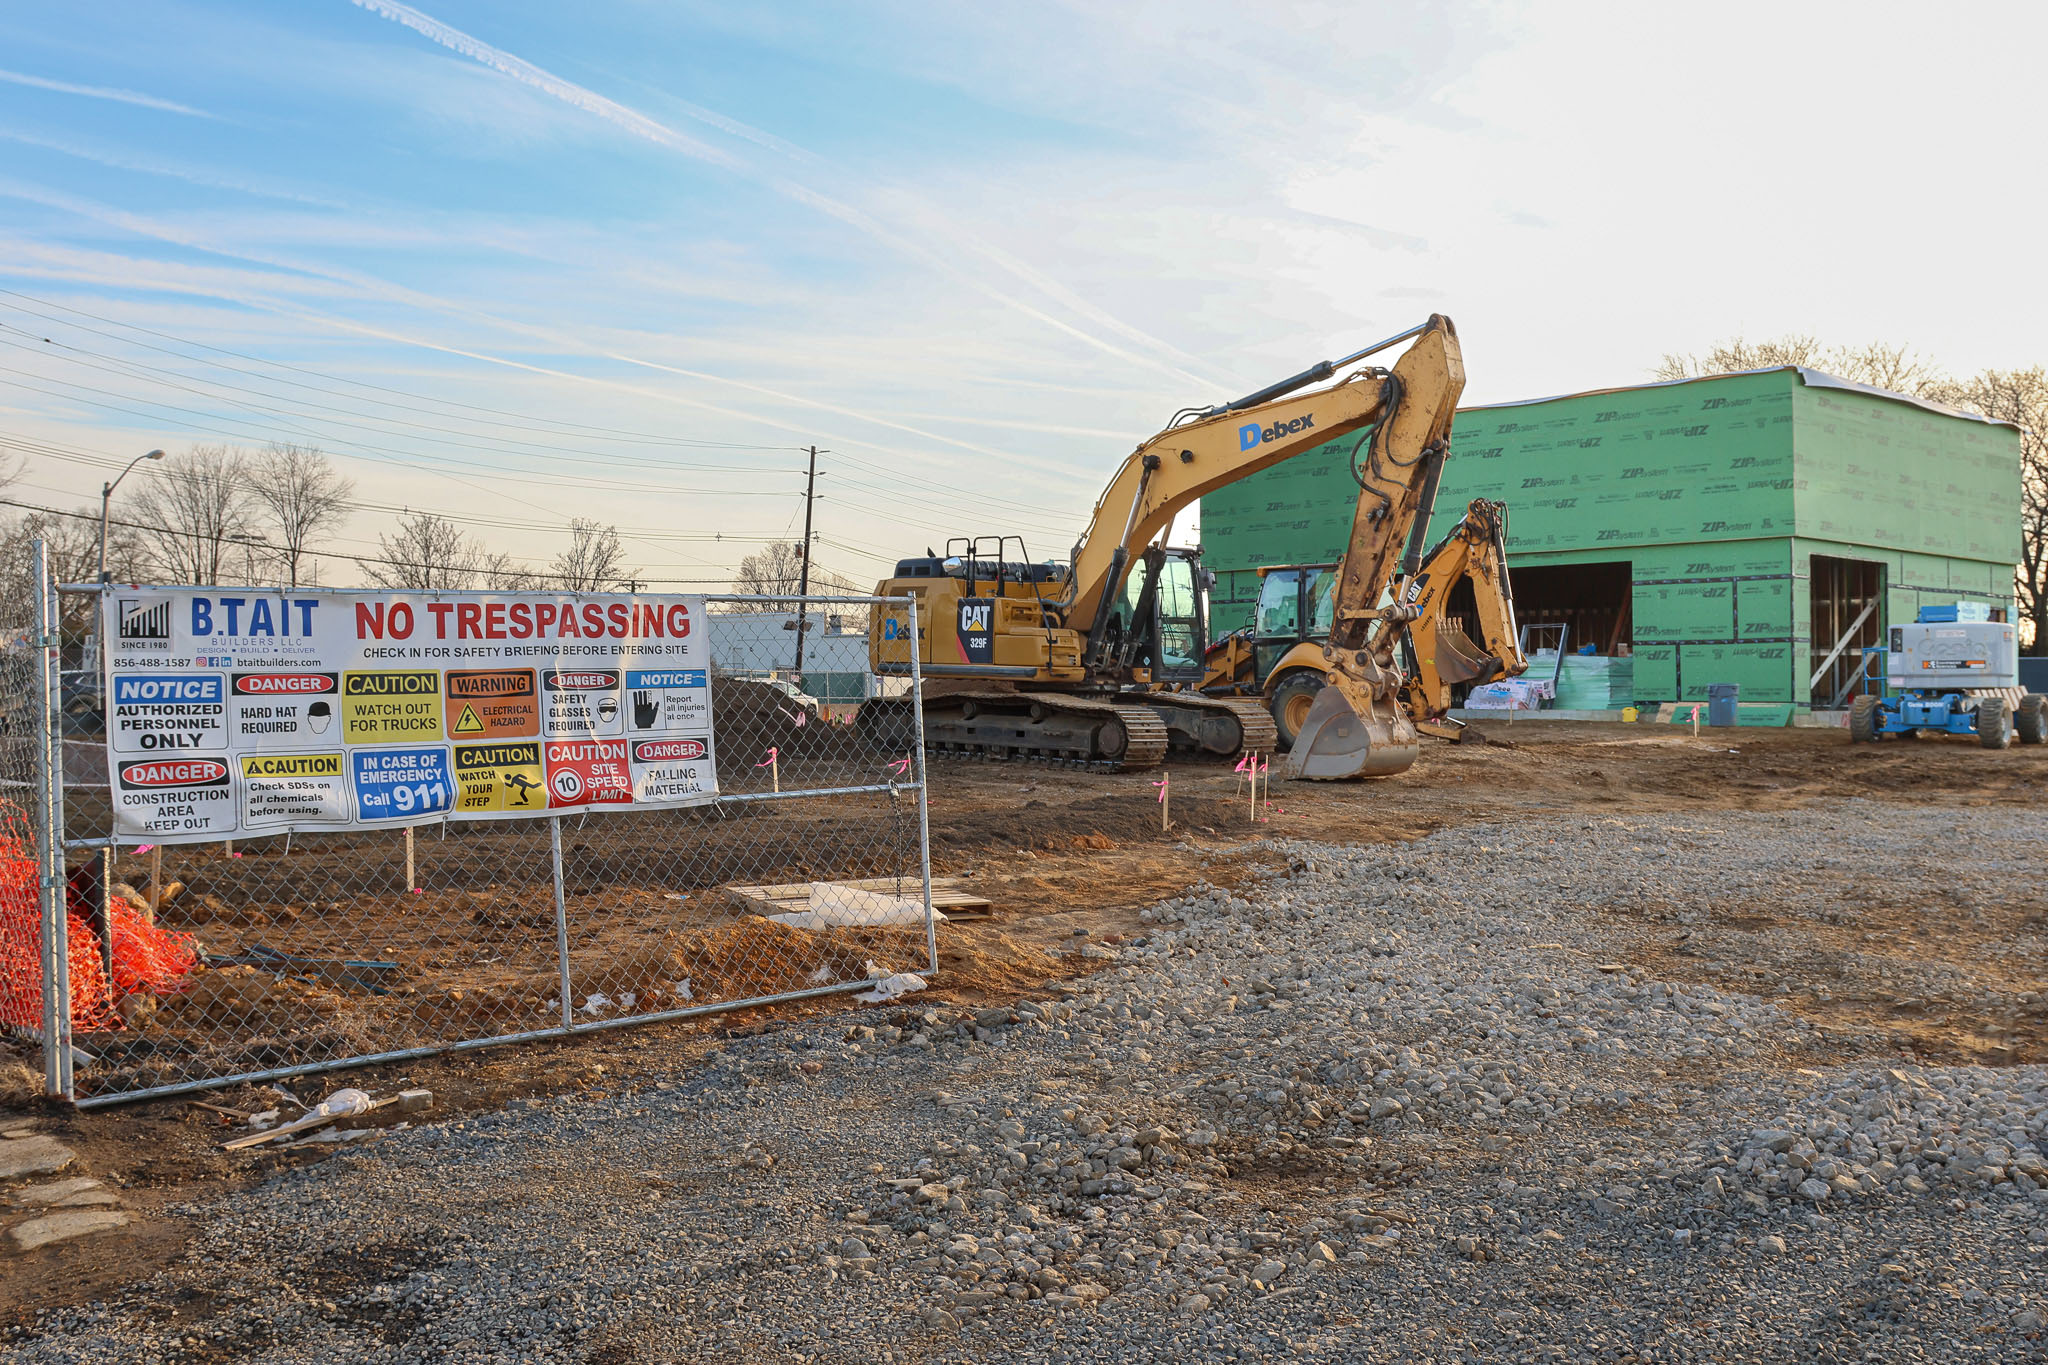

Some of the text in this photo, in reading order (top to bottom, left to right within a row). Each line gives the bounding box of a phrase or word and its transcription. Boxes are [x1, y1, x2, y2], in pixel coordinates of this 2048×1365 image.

[1239, 413, 1315, 451] Debex
[1408, 581, 1423, 602] CAT
[191, 597, 319, 637] B.TAIT
[356, 602, 690, 640] NO TRESPASSING
[962, 605, 990, 632] CAT
[885, 618, 926, 640] Debx
[121, 641, 168, 649] SINCE 1980
[211, 637, 303, 646] BUILDERS LLC
[970, 637, 988, 648] 329F
[363, 645, 688, 658] CHECK IN FOR SAFETY BRIEFING BEFORE ENTERING SITE
[114, 658, 191, 668] 856-488-1587
[237, 657, 321, 667] btaitbuilders.com
[249, 677, 322, 691] DANGER
[348, 675, 435, 693] CAUTION
[456, 676, 526, 693] WARNING
[559, 675, 606, 686] DANGER
[640, 674, 692, 685] NOTICE
[121, 681, 217, 699] NOTICE
[552, 694, 587, 704] SAFETY
[666, 695, 692, 704] Report
[116, 704, 223, 717] AUTHORIZED
[241, 706, 298, 719] HARD HAT
[355, 703, 432, 716] WATCH OUT
[483, 705, 534, 716] ELECTRICAL
[549, 707, 591, 718] GLASSES
[677, 704, 706, 713] injuries
[121, 718, 221, 731] PERSONNEL
[241, 721, 298, 734] REQUIRED
[350, 718, 437, 732] FOR TRUCKS
[490, 717, 526, 727] HAZARD
[549, 721, 596, 732] REQUIRED
[140, 733, 204, 749] ONLY
[461, 748, 535, 765] CAUTION
[548, 744, 625, 762] CAUTION
[643, 744, 697, 758] DANGER
[263, 758, 338, 774] CAUTION
[363, 755, 438, 770] IN CASE OF
[591, 763, 619, 775] SITE
[131, 763, 217, 782] DANGER
[360, 769, 443, 784] EMERGENCY
[459, 770, 496, 781] WATCH
[649, 768, 697, 781] FALLING
[250, 781, 330, 792] Check SDSs on
[558, 777, 577, 793] 10
[587, 776, 628, 789] SPEED
[466, 784, 492, 795] YOUR
[591, 789, 627, 801] LIMIT
[645, 782, 703, 797] MATERIAL
[123, 789, 229, 805] CONSTRUCTION
[250, 793, 324, 804] all chemicals
[363, 782, 445, 811] Call 911
[464, 796, 490, 808] STEP
[157, 805, 195, 817] AREA
[249, 805, 322, 818] before using.
[144, 817, 211, 832] KEEP OUT
